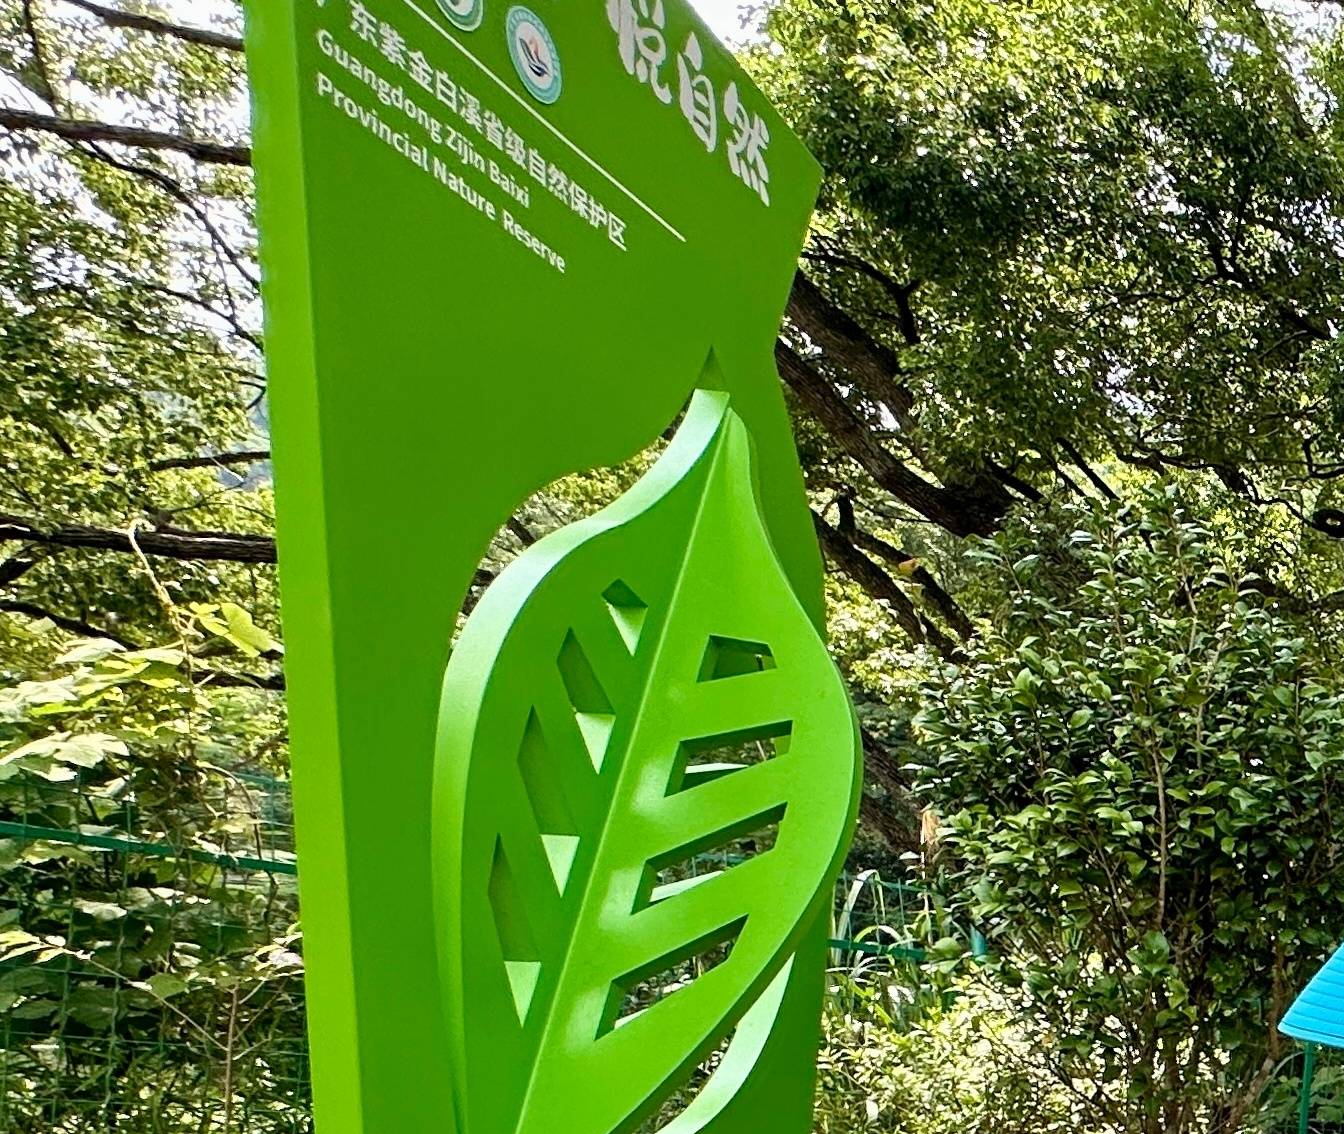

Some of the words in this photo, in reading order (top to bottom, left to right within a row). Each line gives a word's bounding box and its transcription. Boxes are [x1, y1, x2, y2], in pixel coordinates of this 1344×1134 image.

[316, 29, 442, 144] Guangdong
[445, 124, 486, 173] Zijin
[488, 159, 530, 208] Baixi
[316, 0, 627, 251] 东紫金白溪省级自然保护区
[316, 72, 429, 172] Provincial
[433, 156, 496, 220] Nature
[502, 209, 566, 273] Reserve
